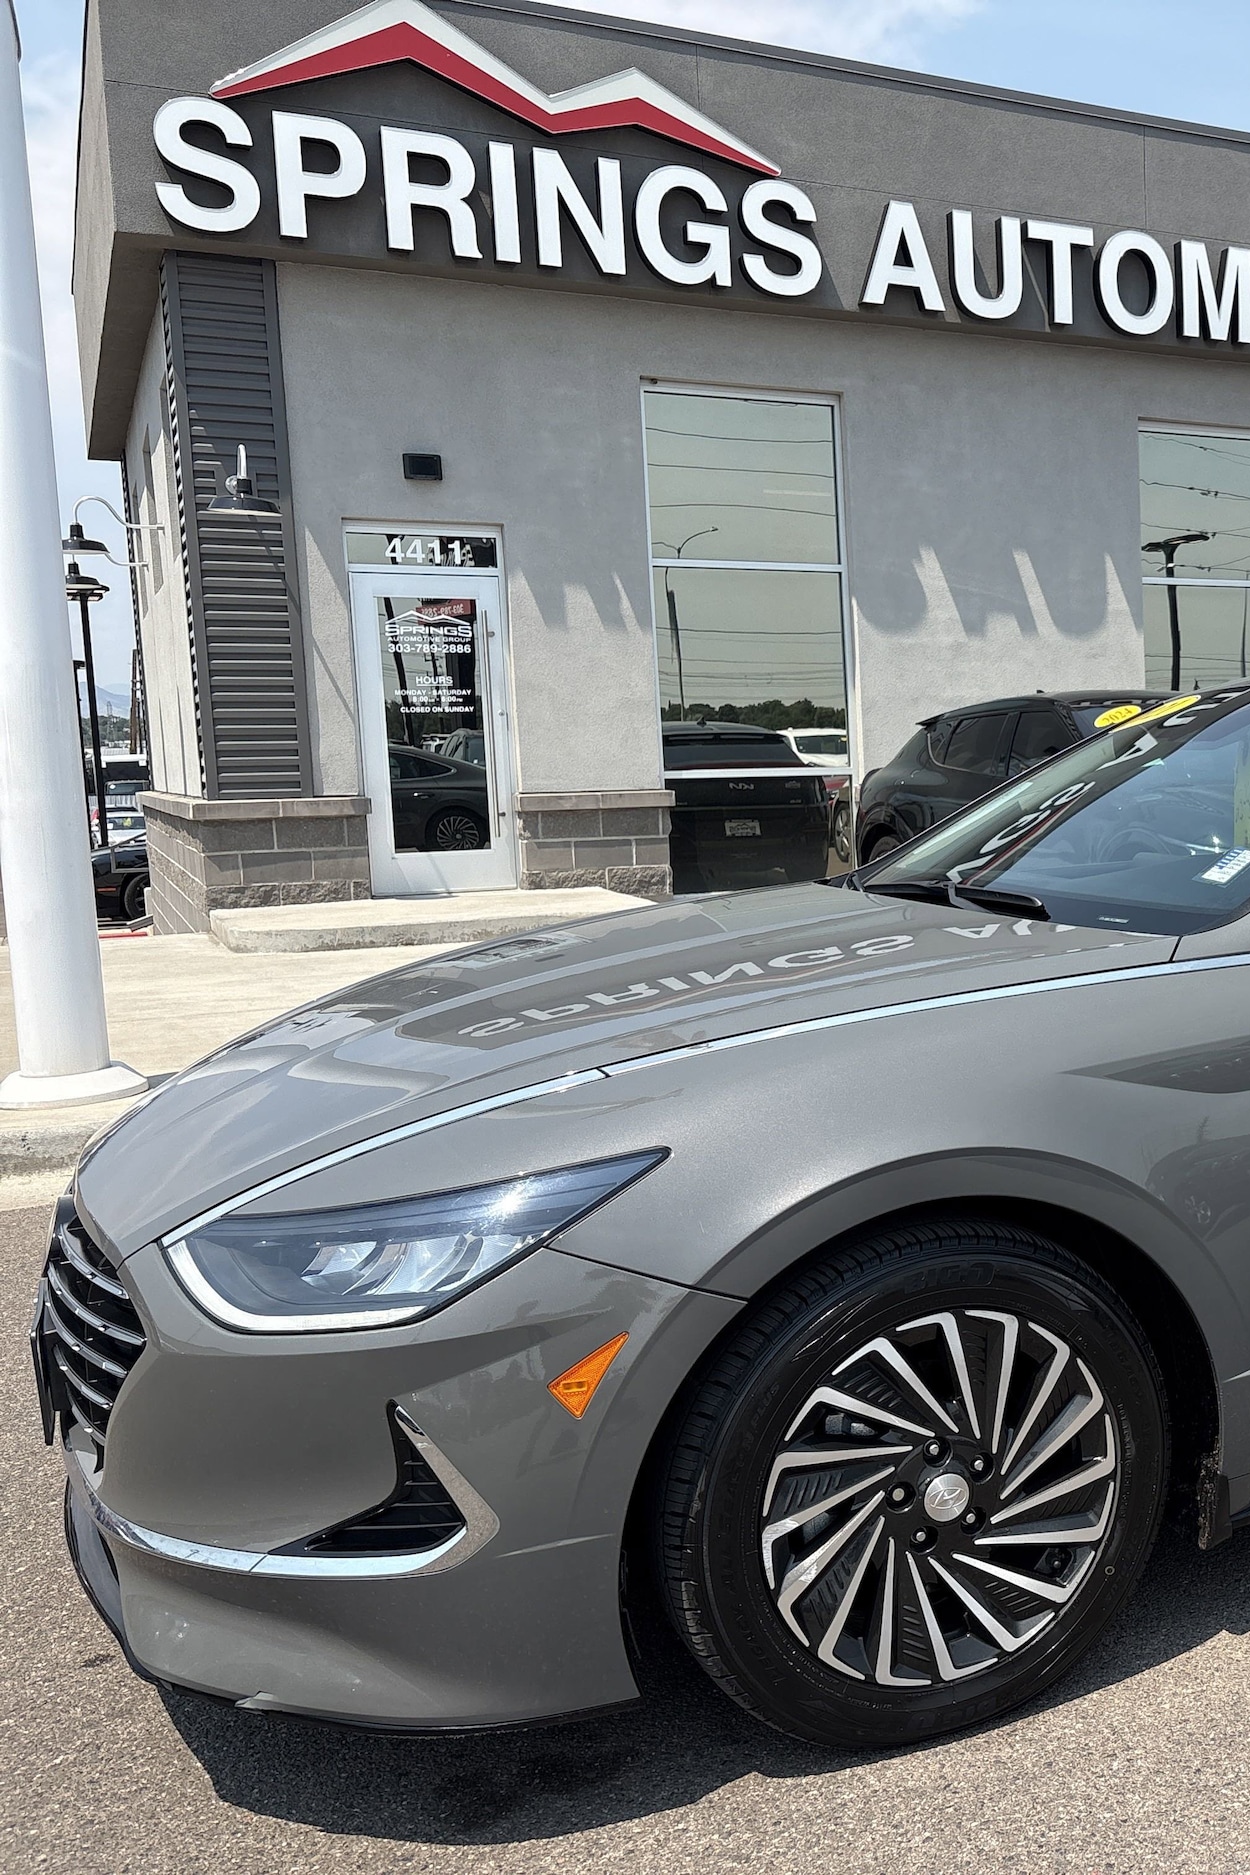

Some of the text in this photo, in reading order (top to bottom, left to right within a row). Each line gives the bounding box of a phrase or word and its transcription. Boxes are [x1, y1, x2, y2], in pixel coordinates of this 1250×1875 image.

[152, 96, 823, 297] SPRINGS
[385, 537, 461, 565] 4411
[384, 624, 472, 637] SPRINGS
[388, 643, 472, 654] 303-789-2886
[415, 675, 453, 685] HOURS
